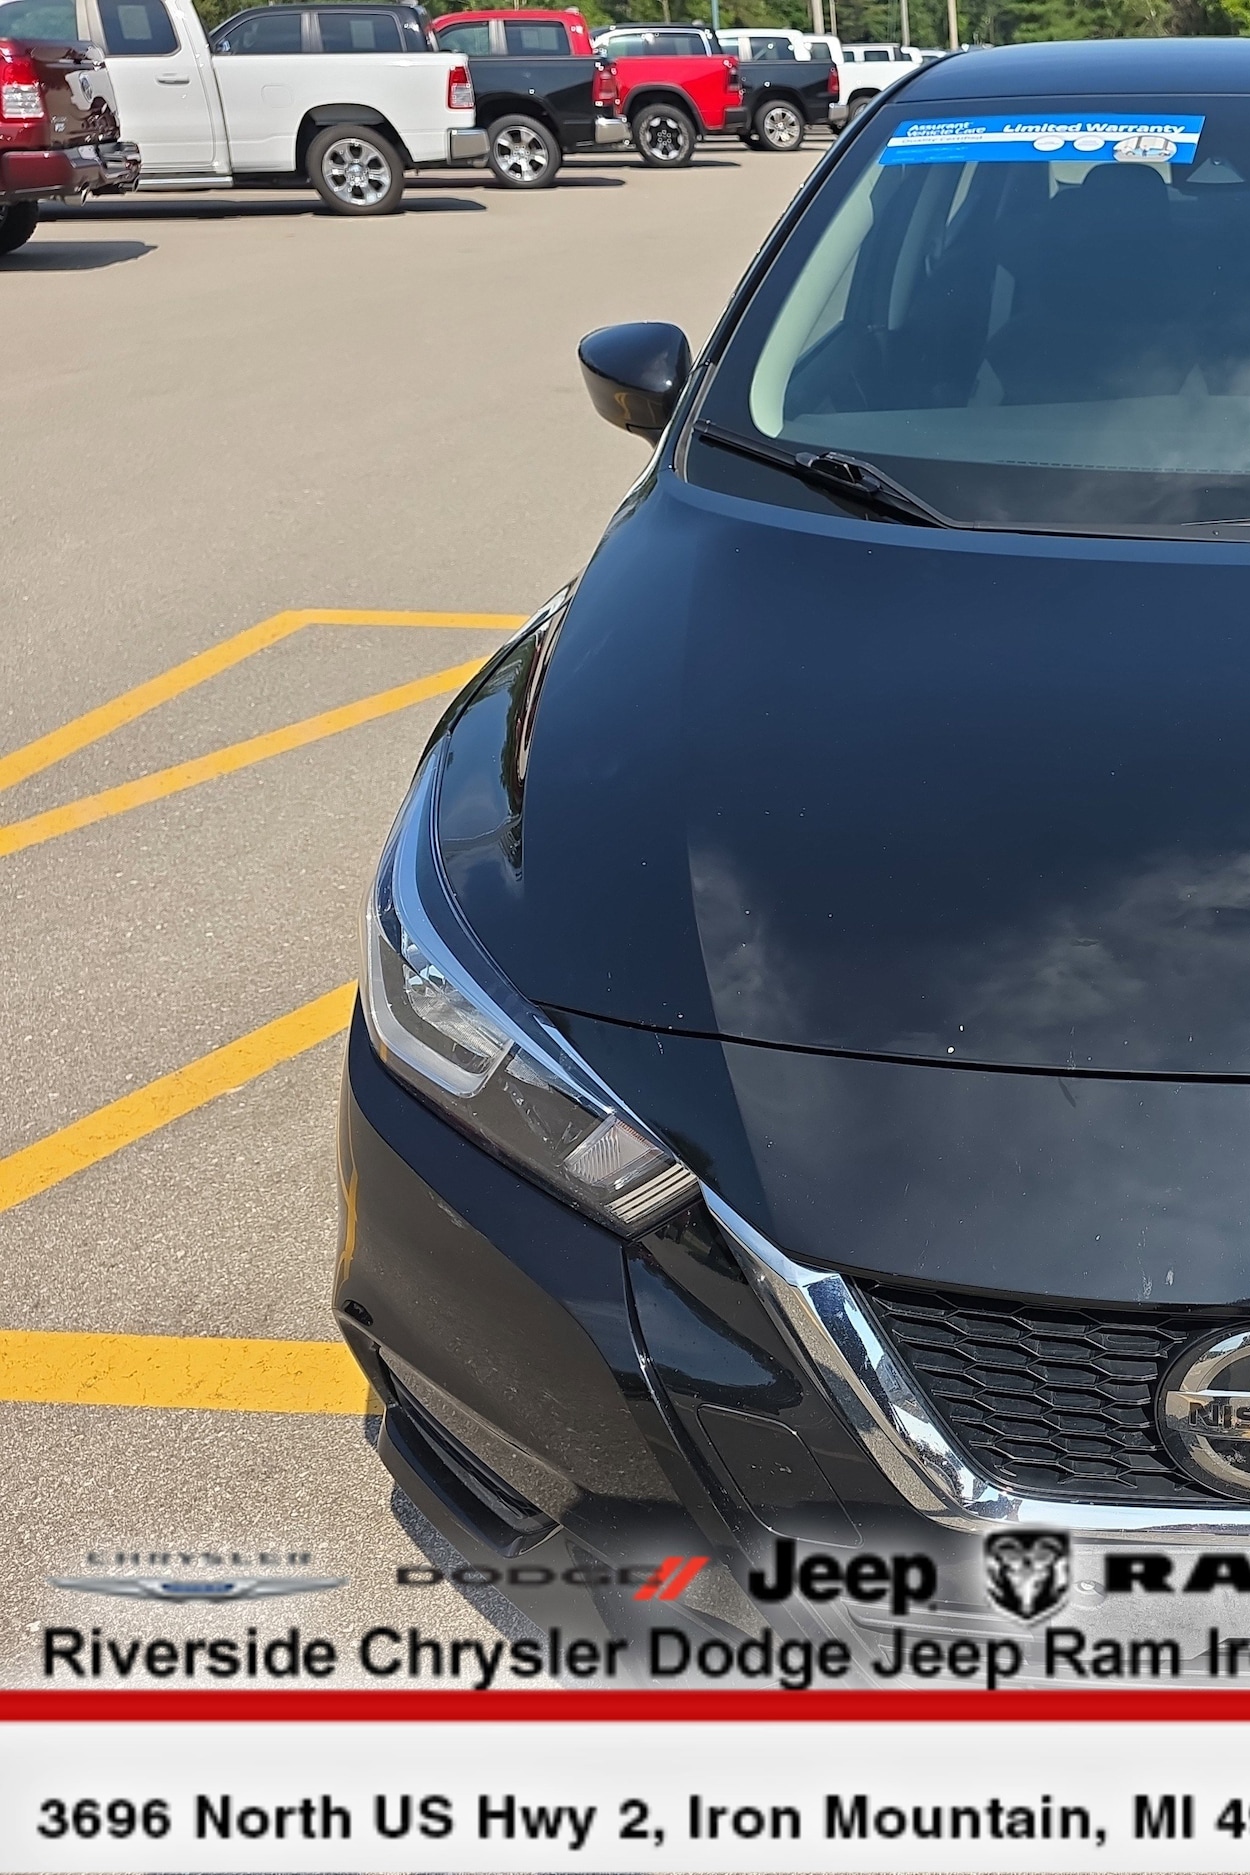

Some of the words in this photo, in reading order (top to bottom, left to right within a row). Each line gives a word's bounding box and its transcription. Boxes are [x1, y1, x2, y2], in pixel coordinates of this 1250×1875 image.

[908, 121, 972, 132] Assurant
[954, 127, 987, 135] Care
[1002, 122, 1083, 133] Limited
[1085, 122, 1186, 135] Warranty
